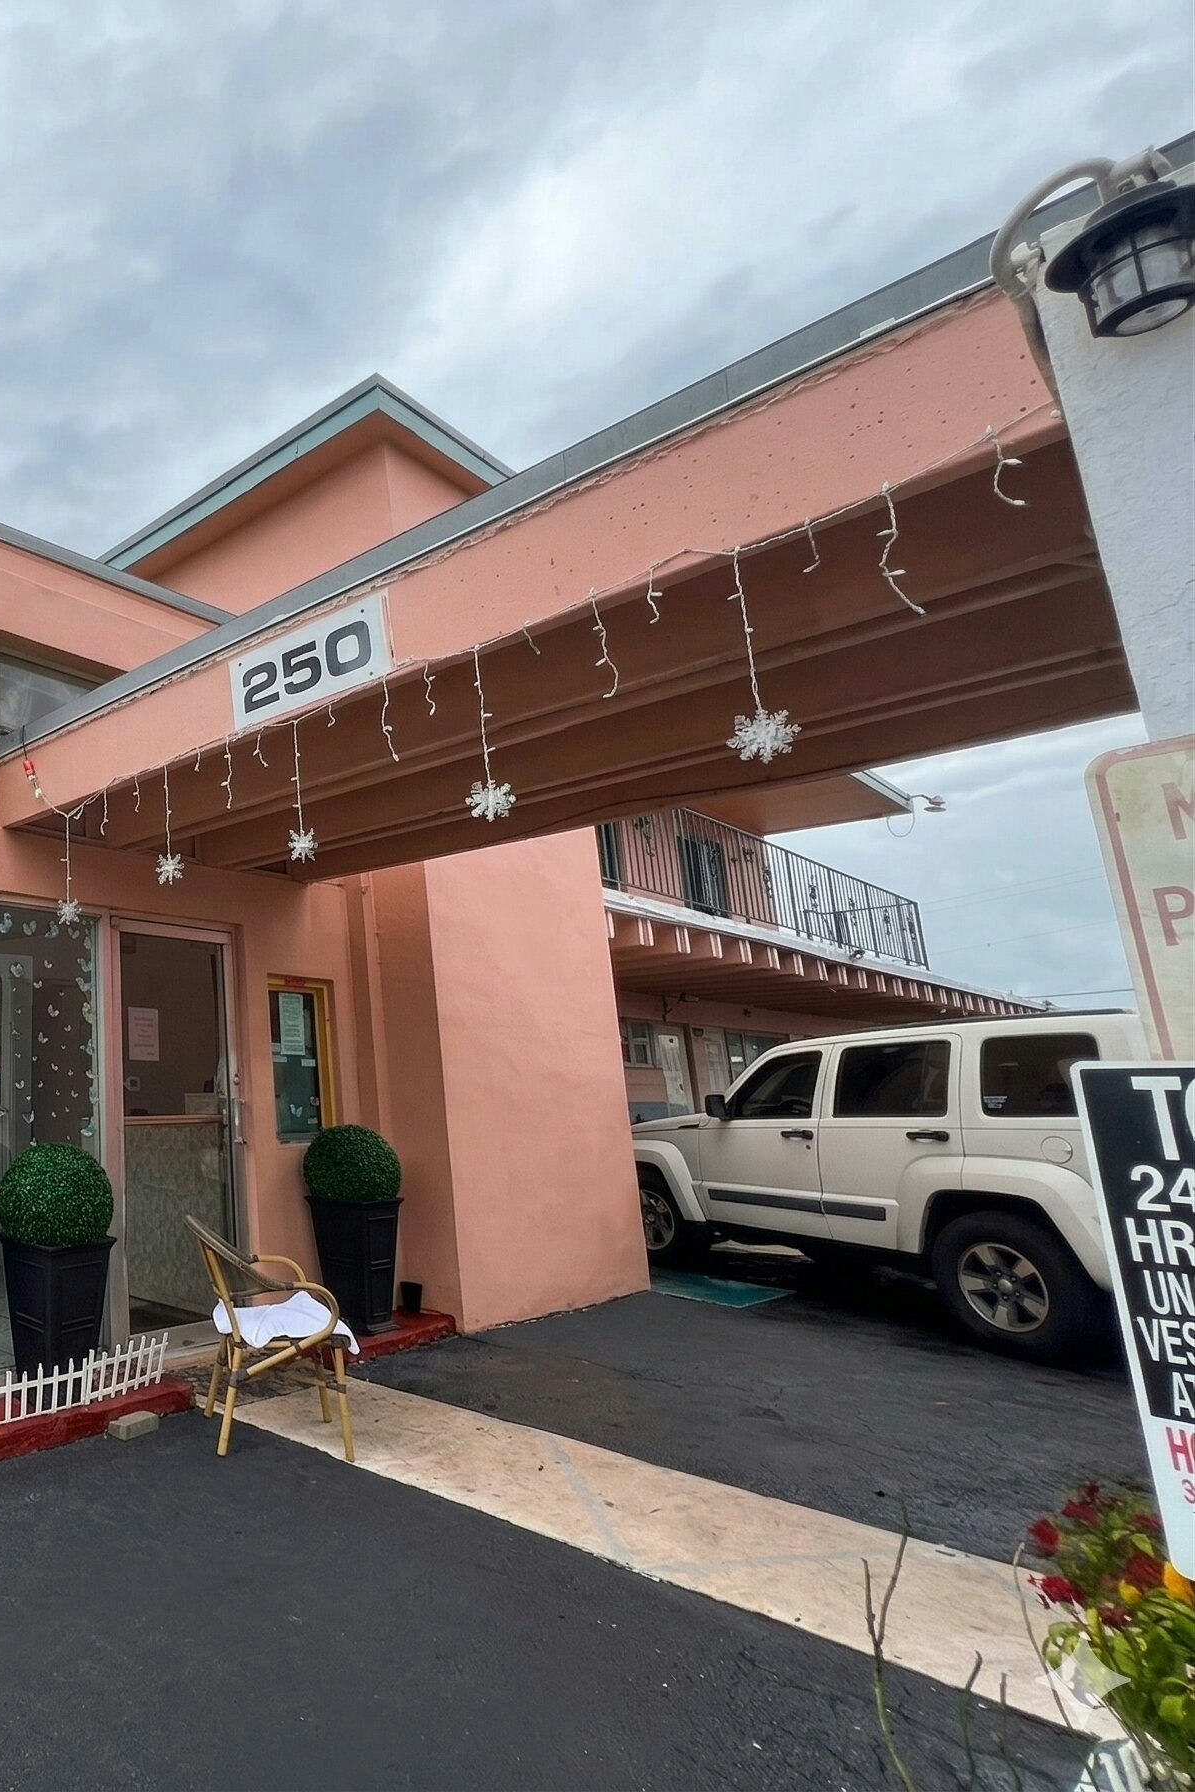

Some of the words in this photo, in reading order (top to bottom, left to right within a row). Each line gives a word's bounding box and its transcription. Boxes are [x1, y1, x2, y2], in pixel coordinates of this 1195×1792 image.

[242, 620, 372, 714] 250
[1130, 1075, 1195, 1161] T
[1165, 1426, 1195, 1475] H
